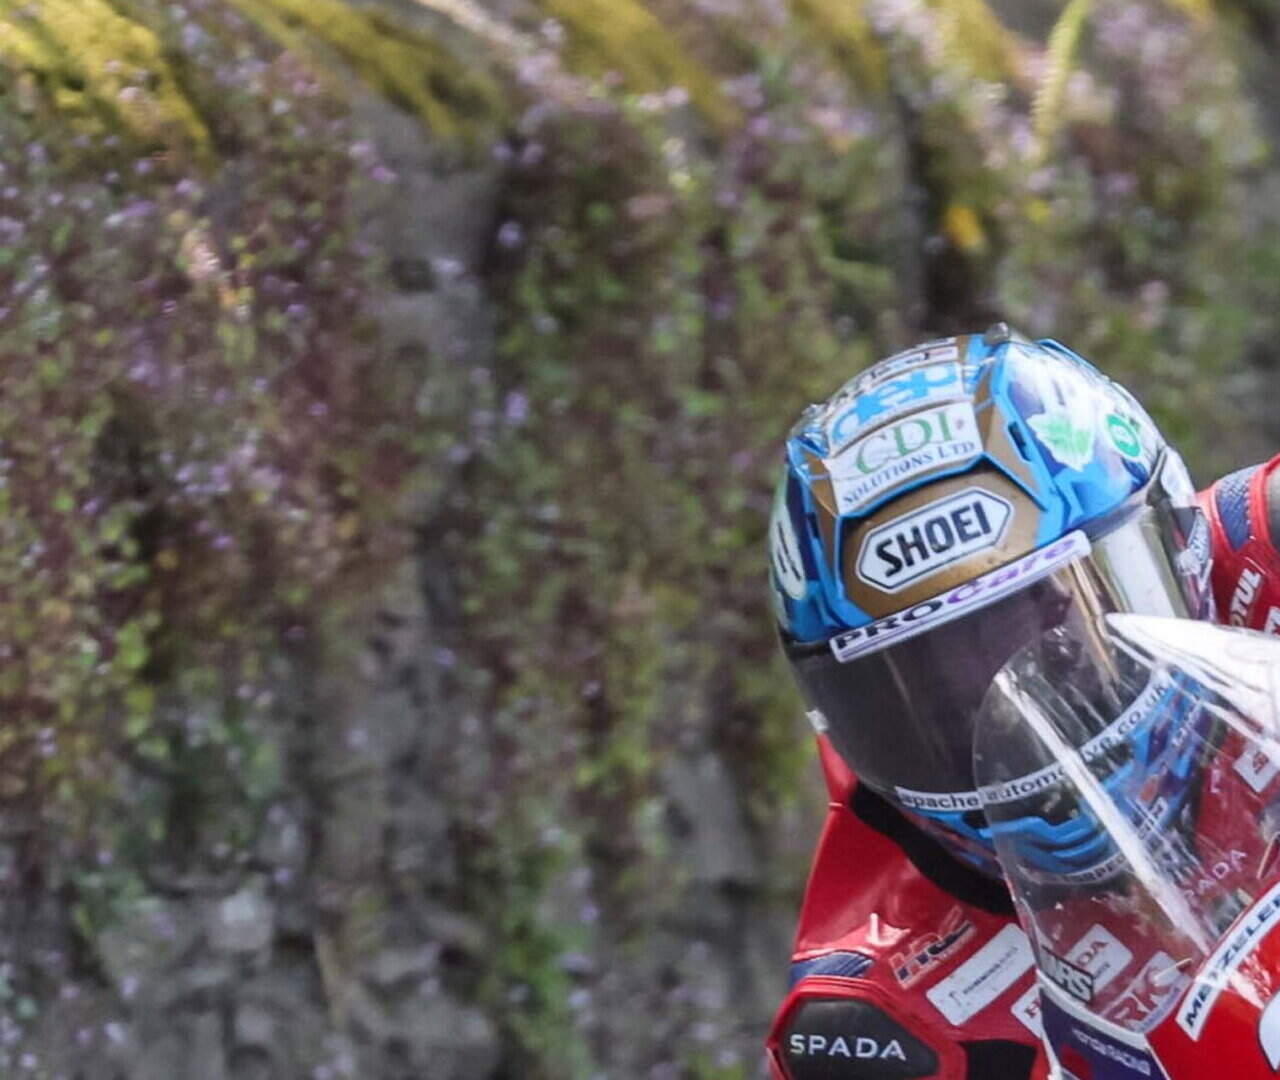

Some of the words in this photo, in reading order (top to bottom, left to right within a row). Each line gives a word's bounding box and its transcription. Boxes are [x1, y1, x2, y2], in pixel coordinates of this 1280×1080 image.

[842, 452, 933, 505] SOLUTIONS
[938, 441, 976, 460] LTD
[876, 502, 993, 578] SHOEI
[790, 1033, 907, 1061] SPADA
